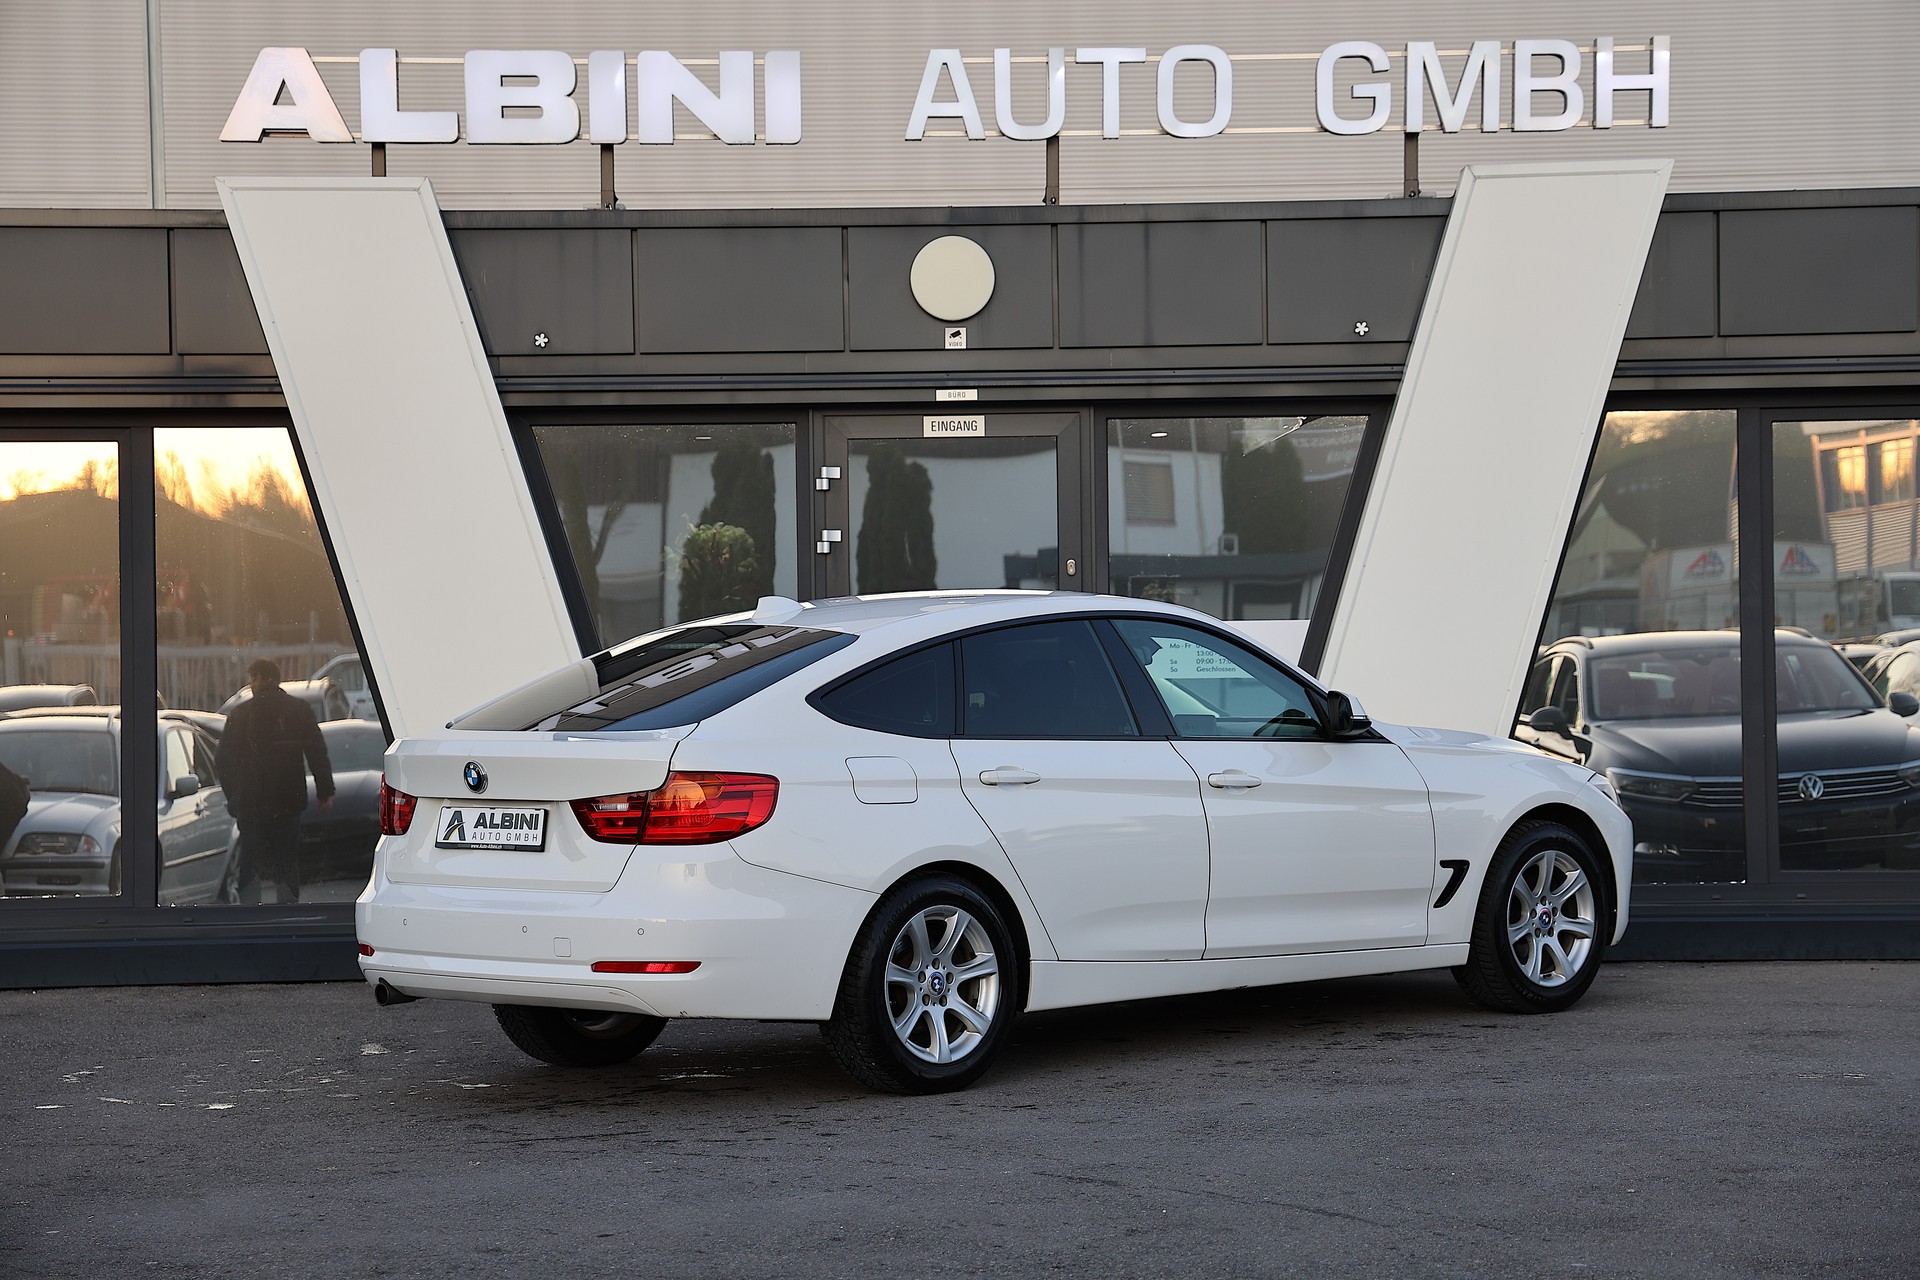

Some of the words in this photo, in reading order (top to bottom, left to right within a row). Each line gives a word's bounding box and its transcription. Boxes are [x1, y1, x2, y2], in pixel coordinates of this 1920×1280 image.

[219, 47, 802, 145] ALBINI
[904, 44, 1234, 140] AUTO
[1315, 34, 1671, 135] GMBH
[931, 420, 978, 431] EINGANG
[473, 812, 540, 831] ALBINI
[471, 832, 501, 841] AUTO
[506, 833, 538, 842] GMBH
